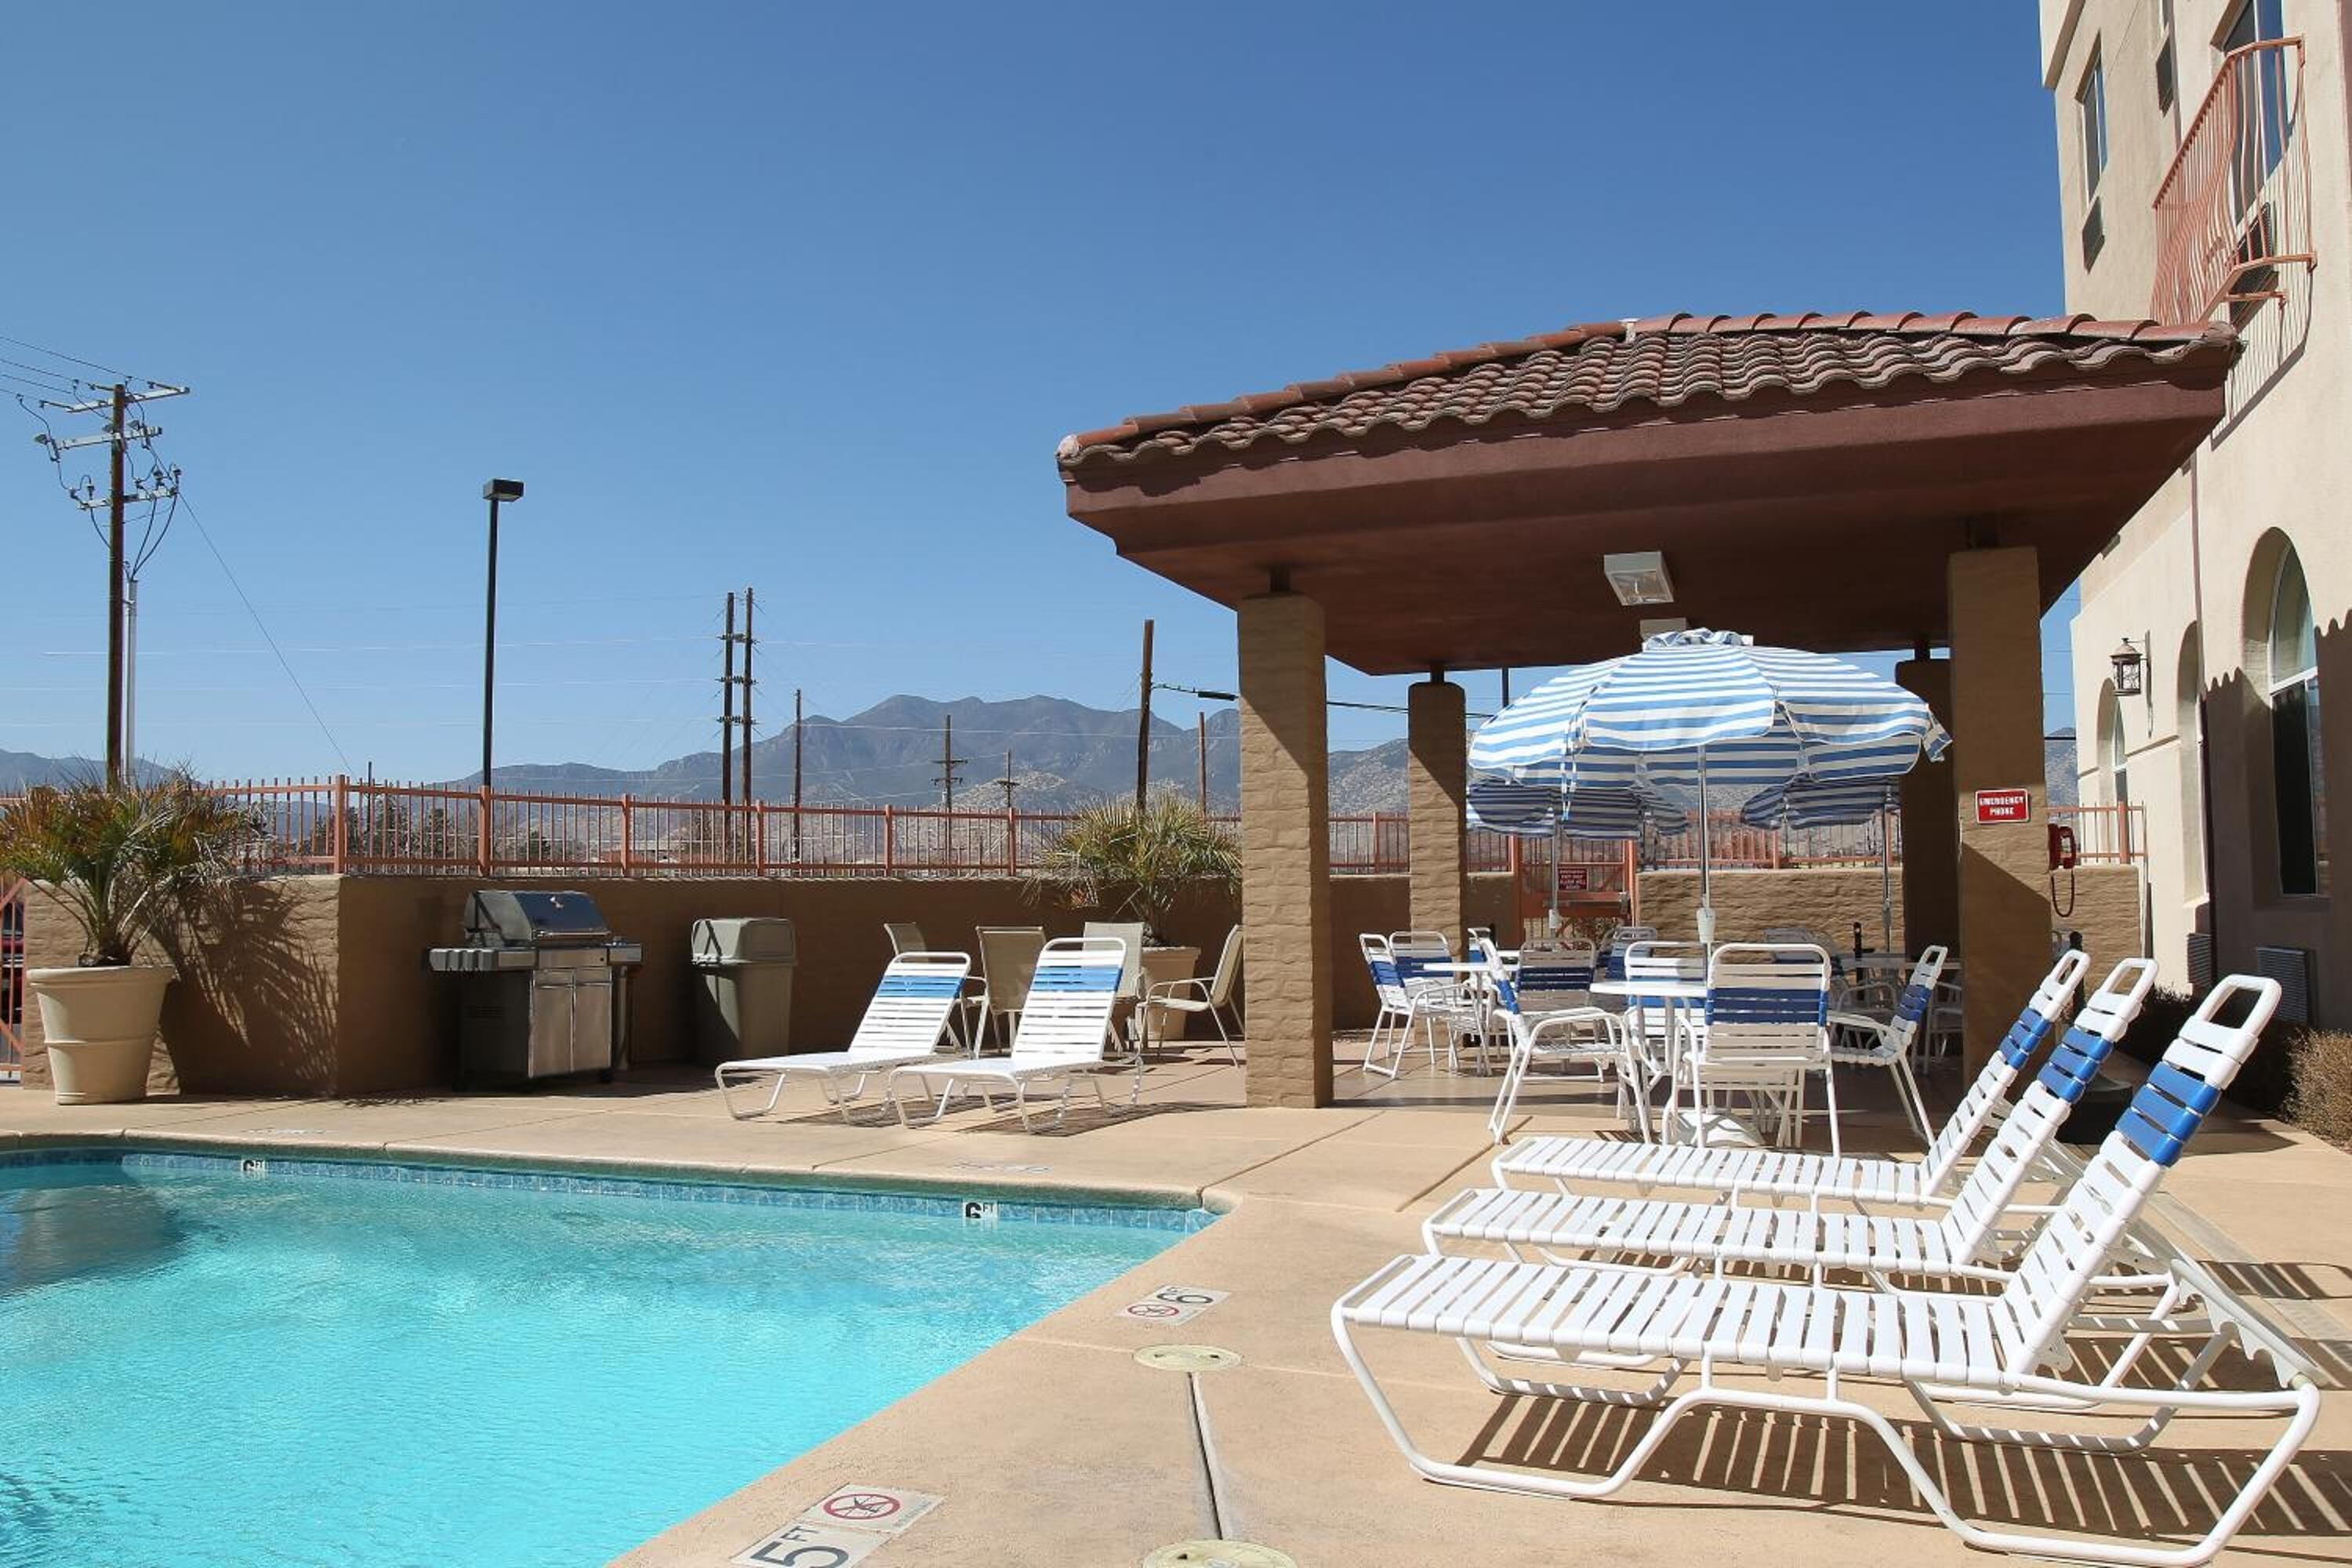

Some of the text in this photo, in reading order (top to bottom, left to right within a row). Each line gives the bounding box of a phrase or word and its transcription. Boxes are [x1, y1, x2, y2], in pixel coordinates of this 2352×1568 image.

[1979, 796, 2024, 806] EMERGENCY
[1989, 807, 2014, 815] PHONE
[750, 1525, 849, 1568] 5 FT
